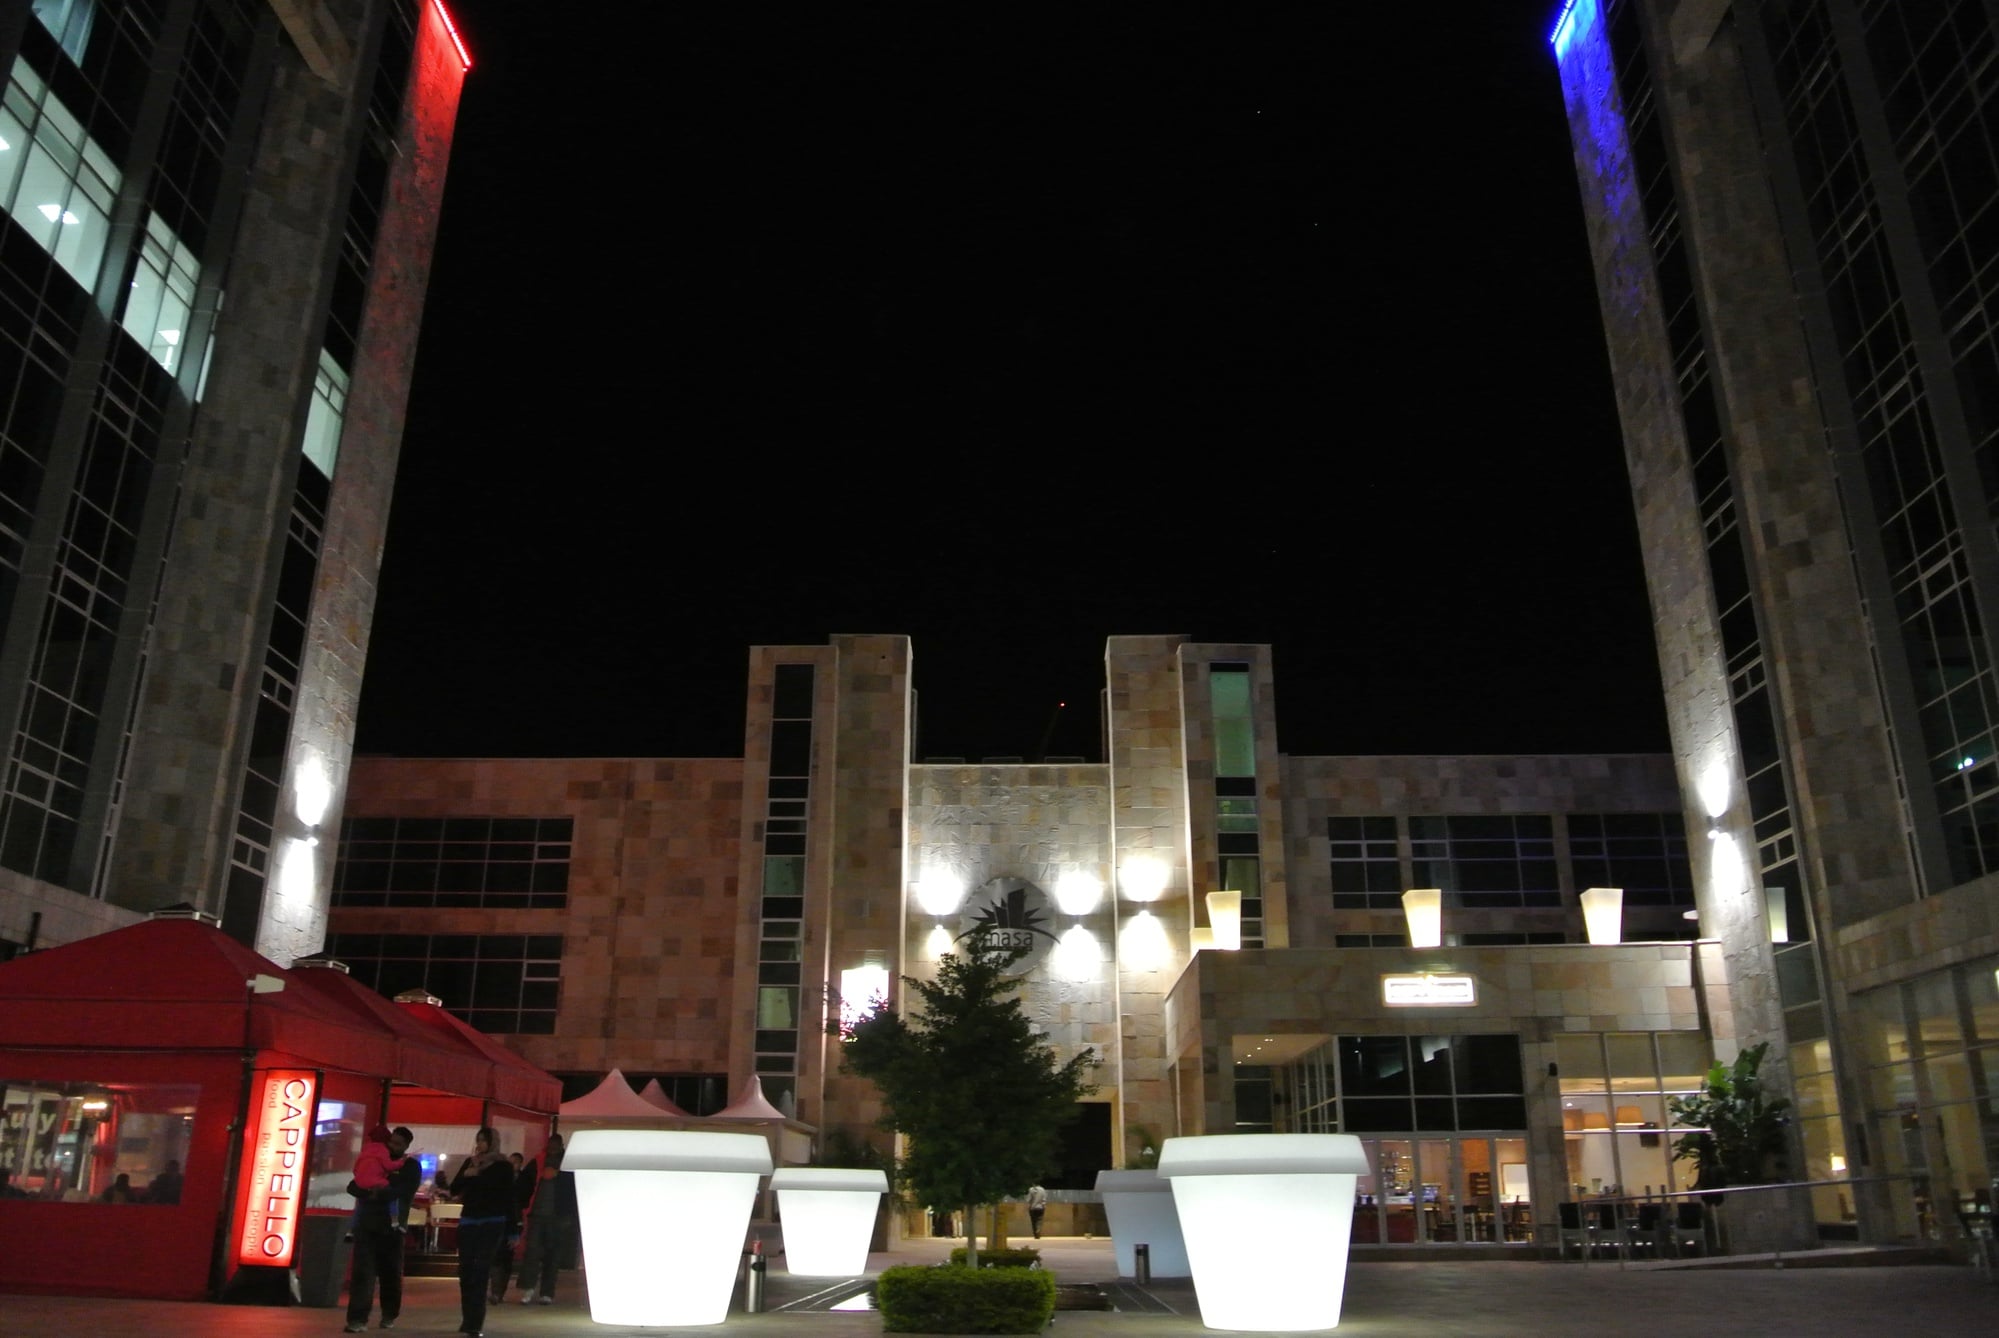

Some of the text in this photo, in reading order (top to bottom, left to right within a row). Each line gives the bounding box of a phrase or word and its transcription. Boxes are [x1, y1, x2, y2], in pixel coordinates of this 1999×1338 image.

[247, 1079, 281, 1256] food passion people
[261, 1078, 309, 1257] CAPPELLO
